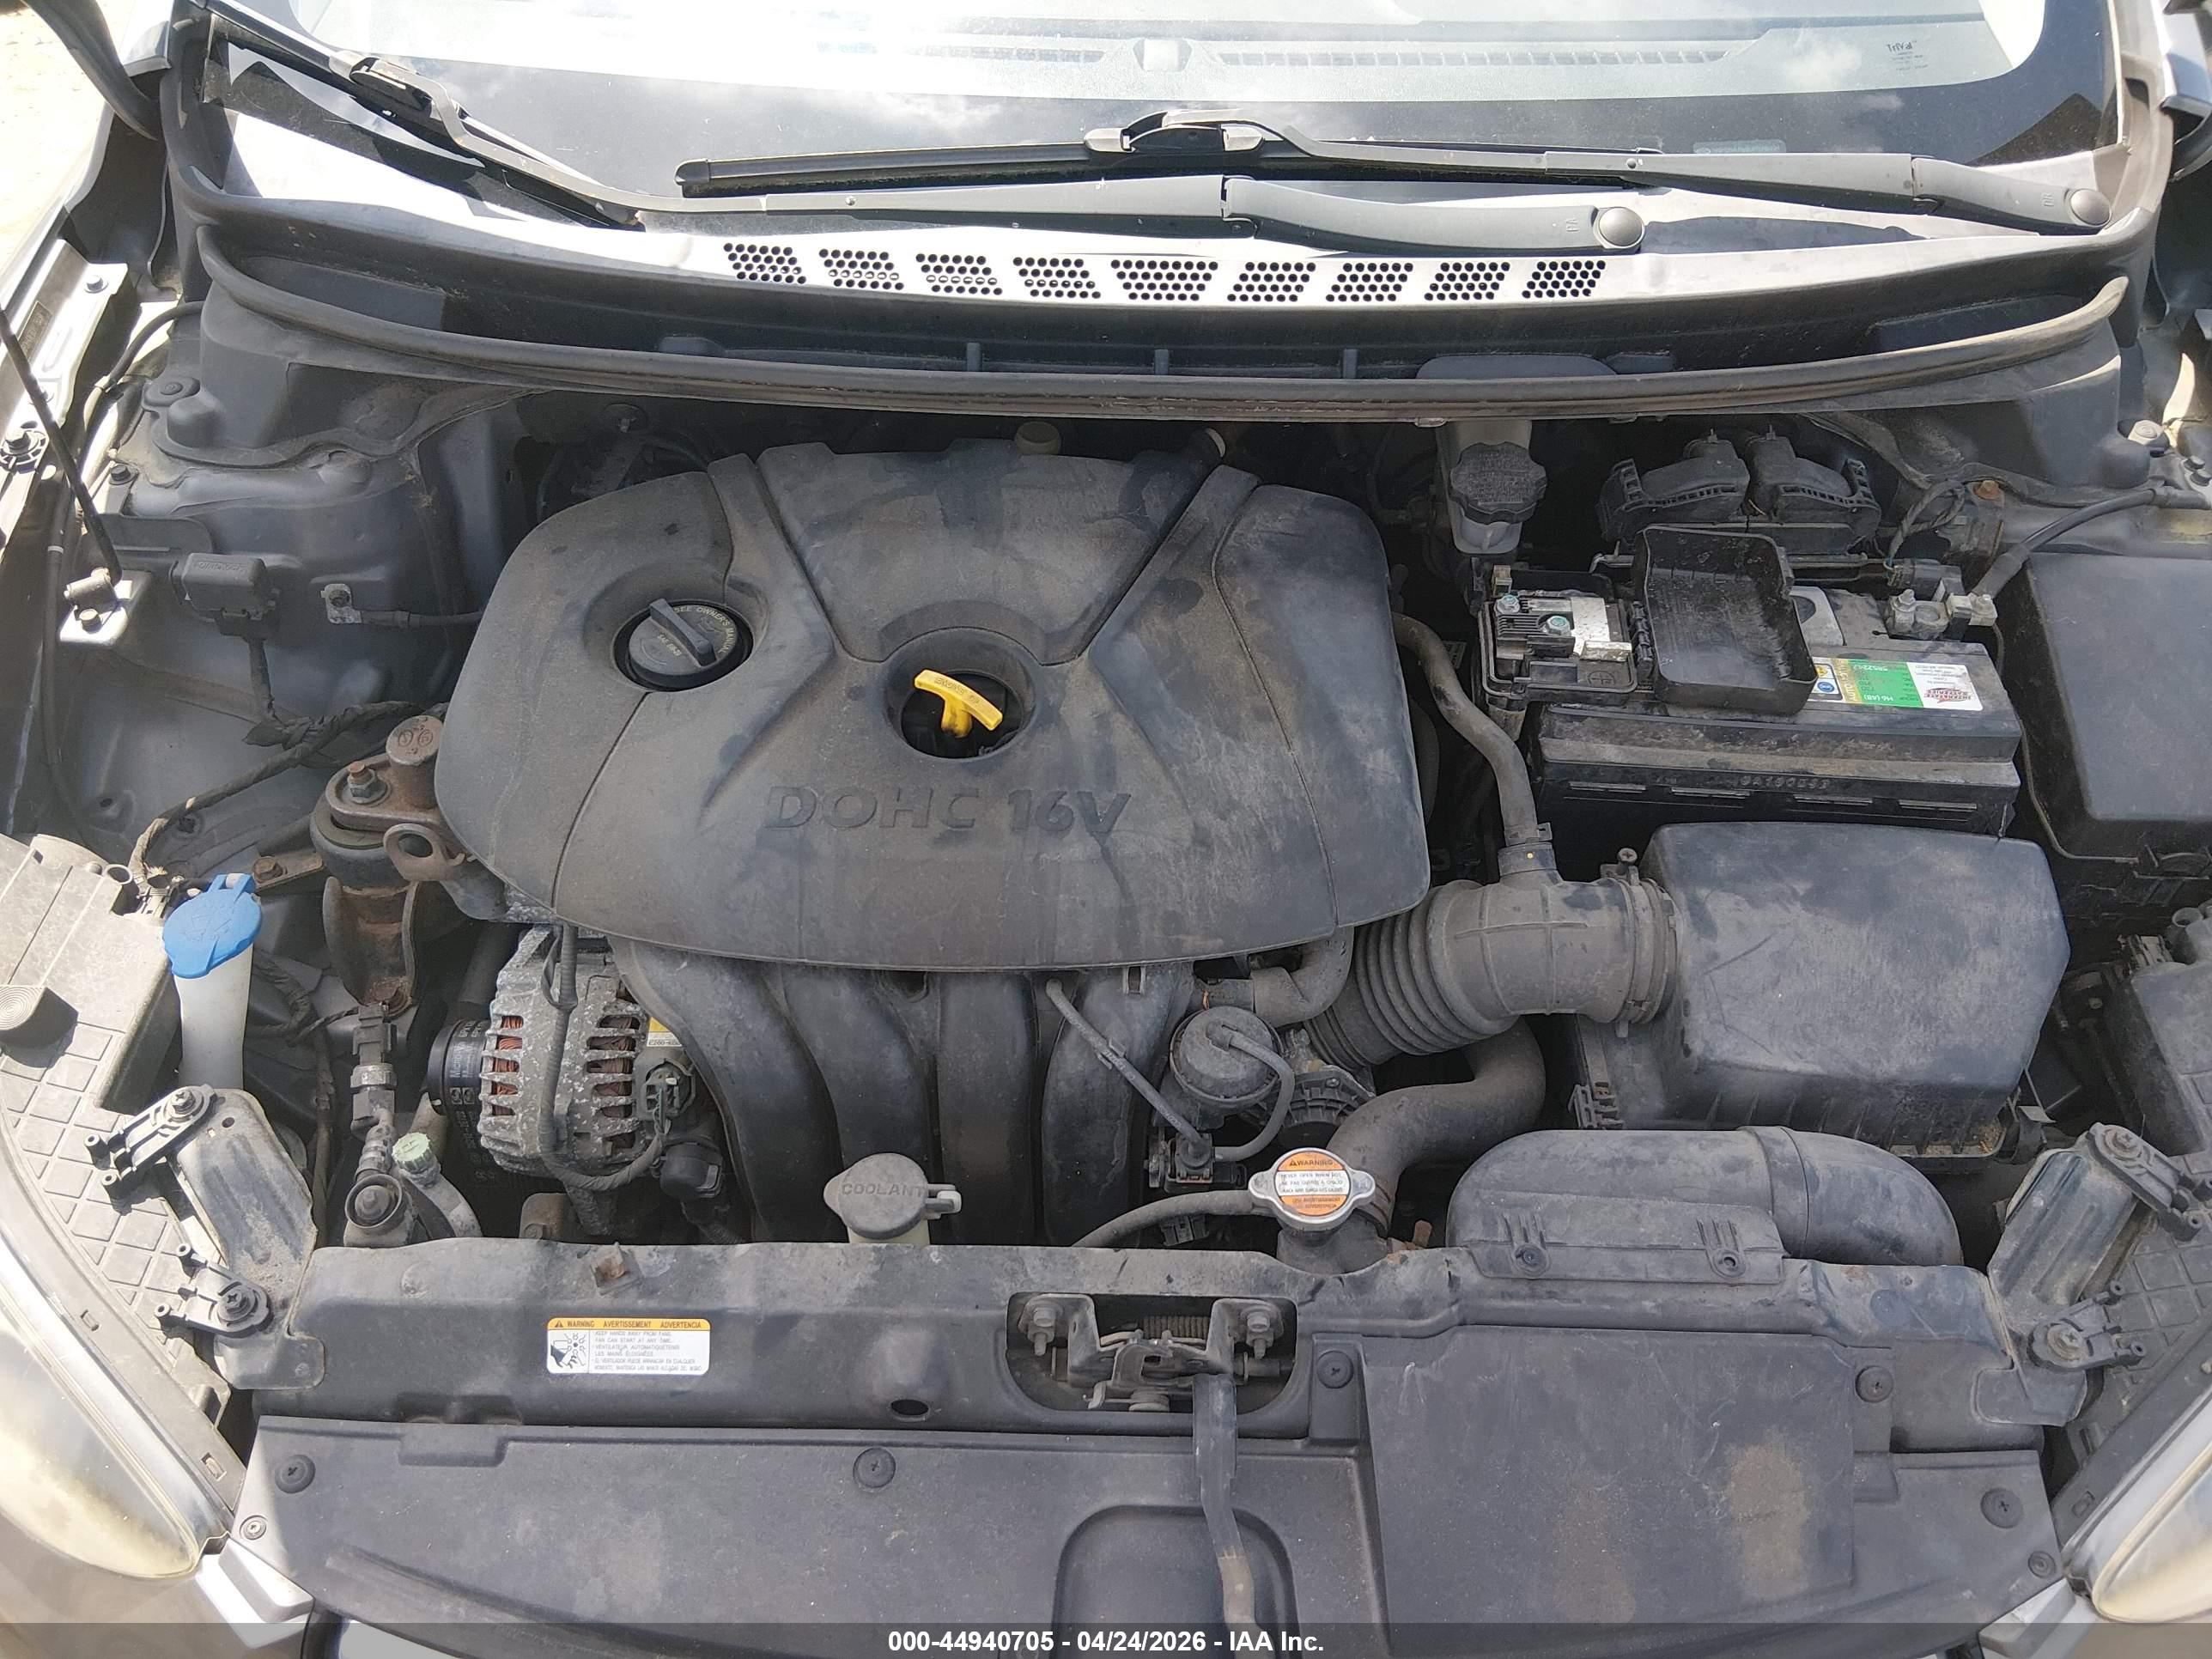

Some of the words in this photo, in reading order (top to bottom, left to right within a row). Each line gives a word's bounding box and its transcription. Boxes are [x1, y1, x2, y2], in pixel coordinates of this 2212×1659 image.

[765, 786, 979, 830] DOHC
[1007, 789, 1132, 834] 16V
[841, 1183, 923, 1198] COOLANT
